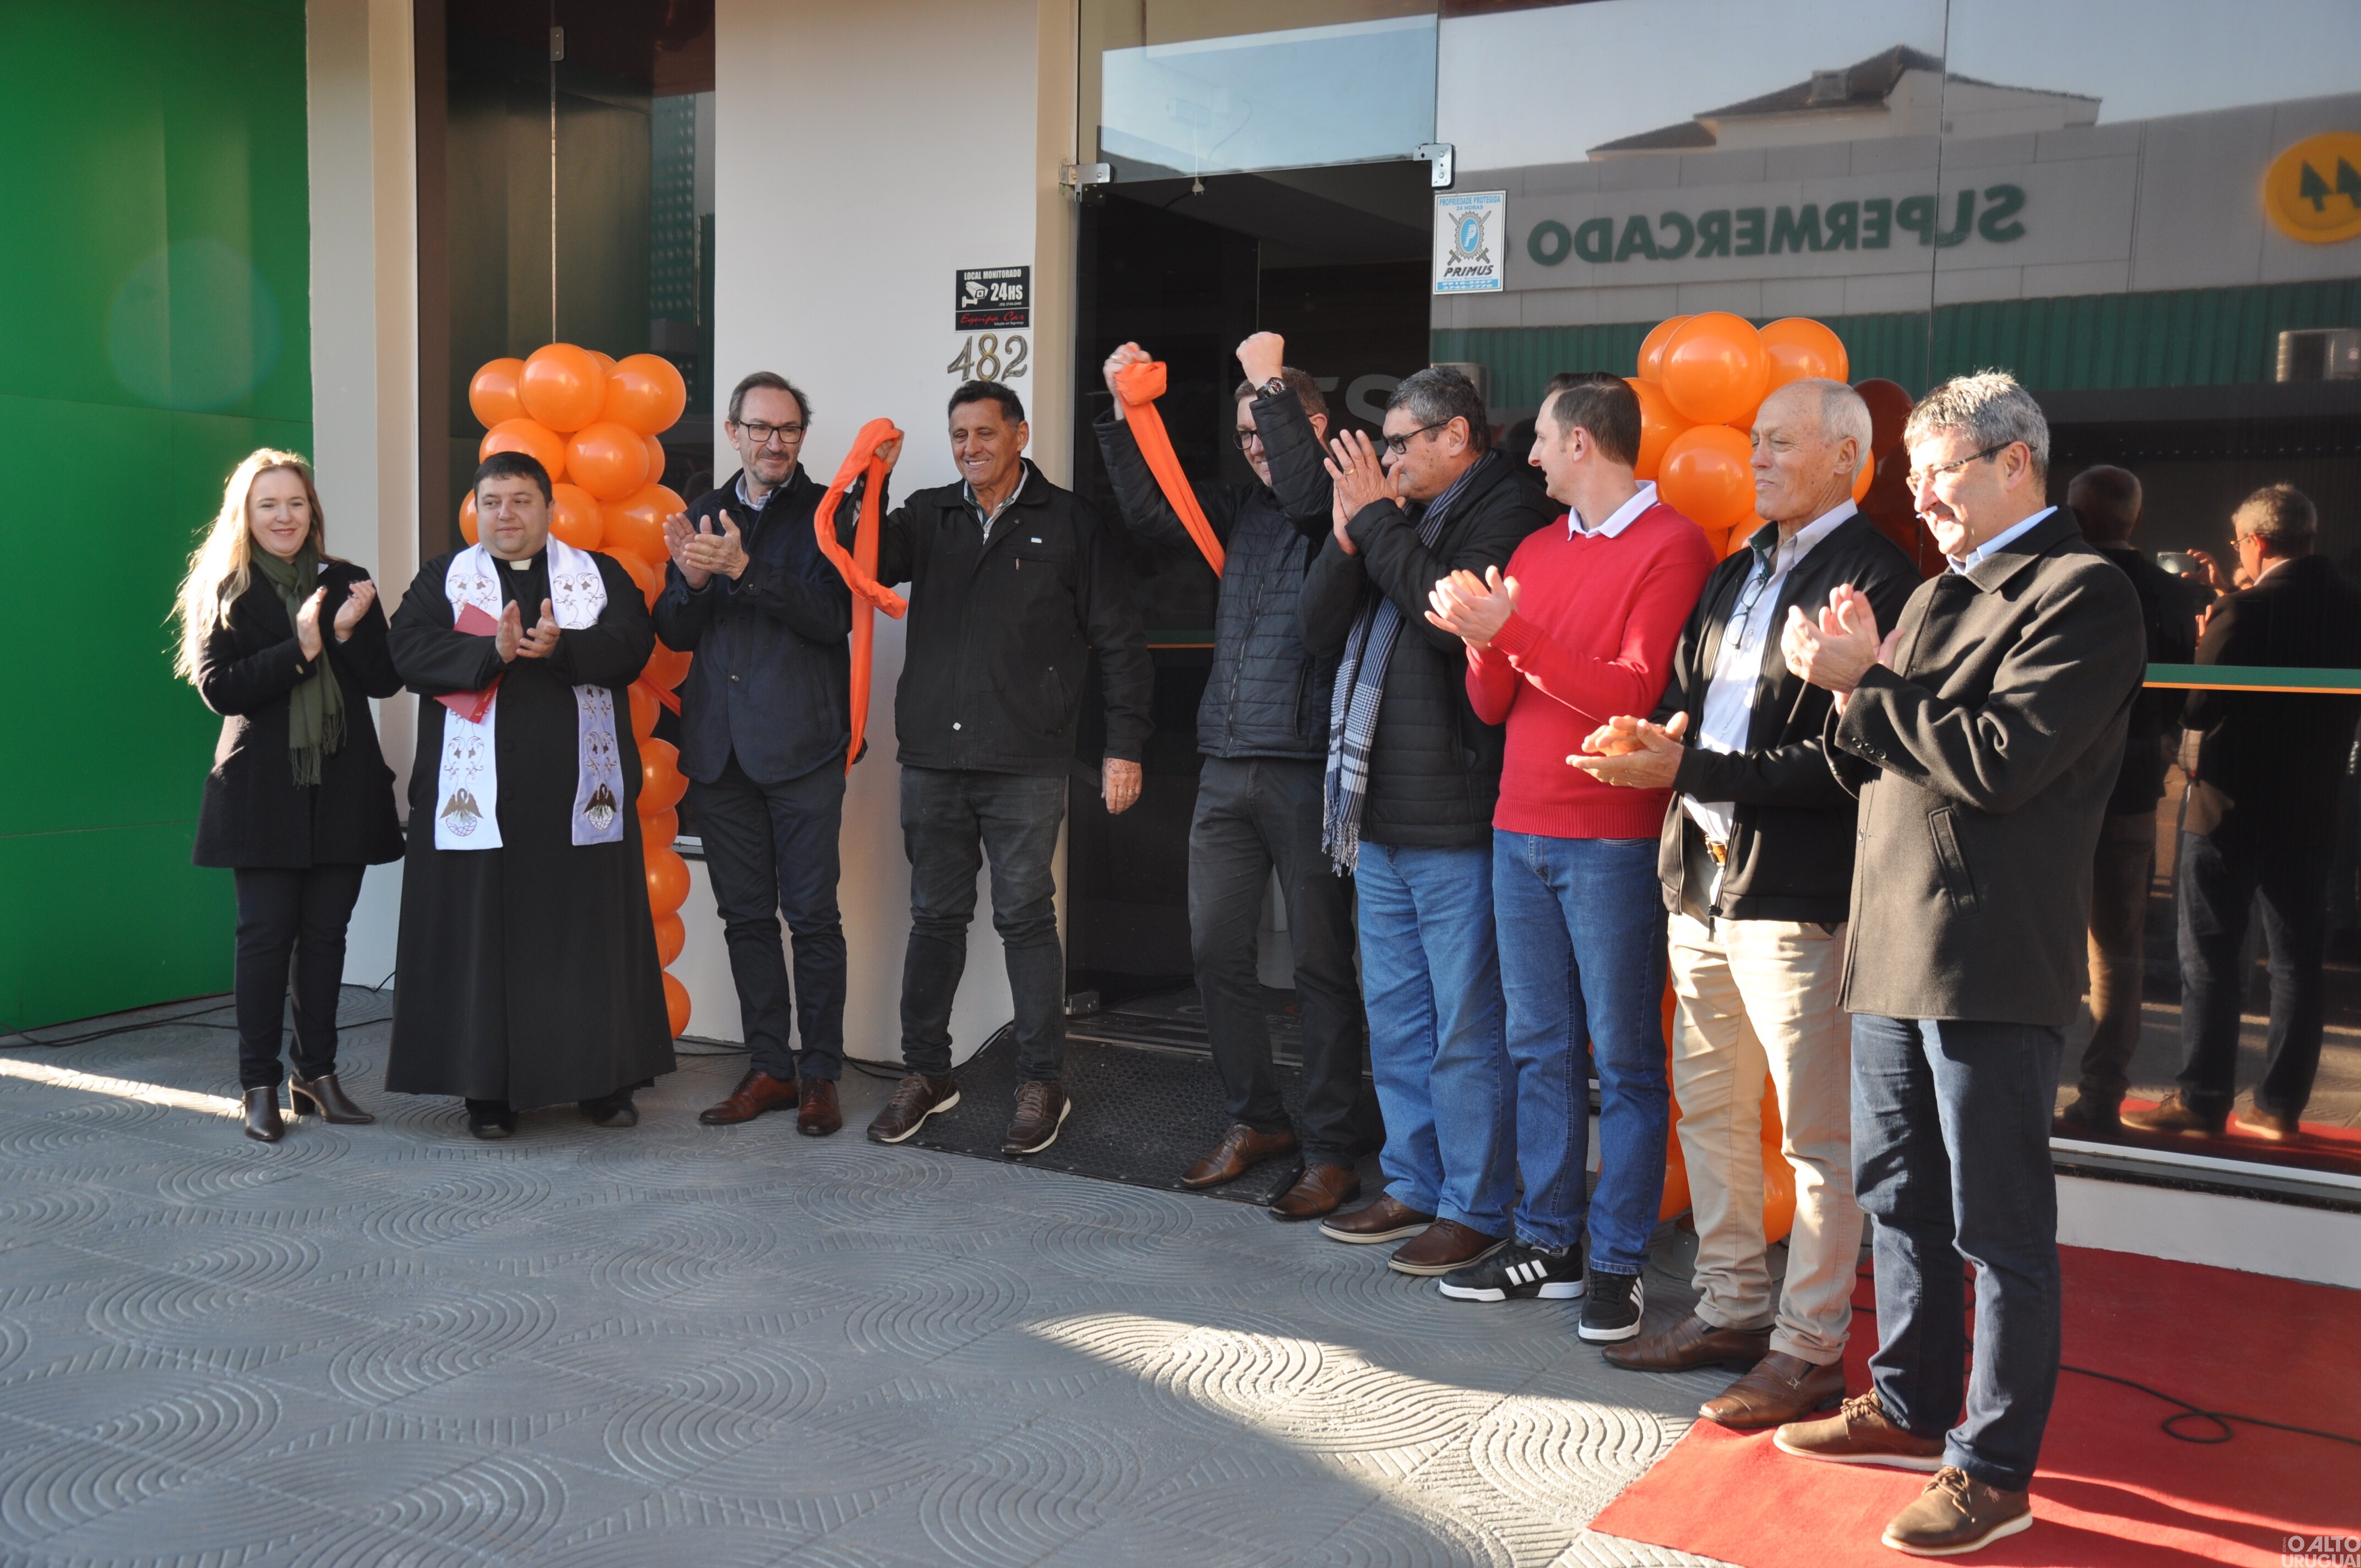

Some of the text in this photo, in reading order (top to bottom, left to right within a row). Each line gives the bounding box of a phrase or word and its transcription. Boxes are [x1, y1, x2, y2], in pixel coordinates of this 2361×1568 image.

[1439, 195, 1500, 206] PROPRIEDADE PROTEGIDA
[964, 269, 1021, 280] LOCAL MONITORADO
[1443, 265, 1494, 277] PRIMUS
[991, 282, 1023, 301] 24HS
[1003, 311, 1025, 321] Car
[947, 333, 1028, 382] 482
